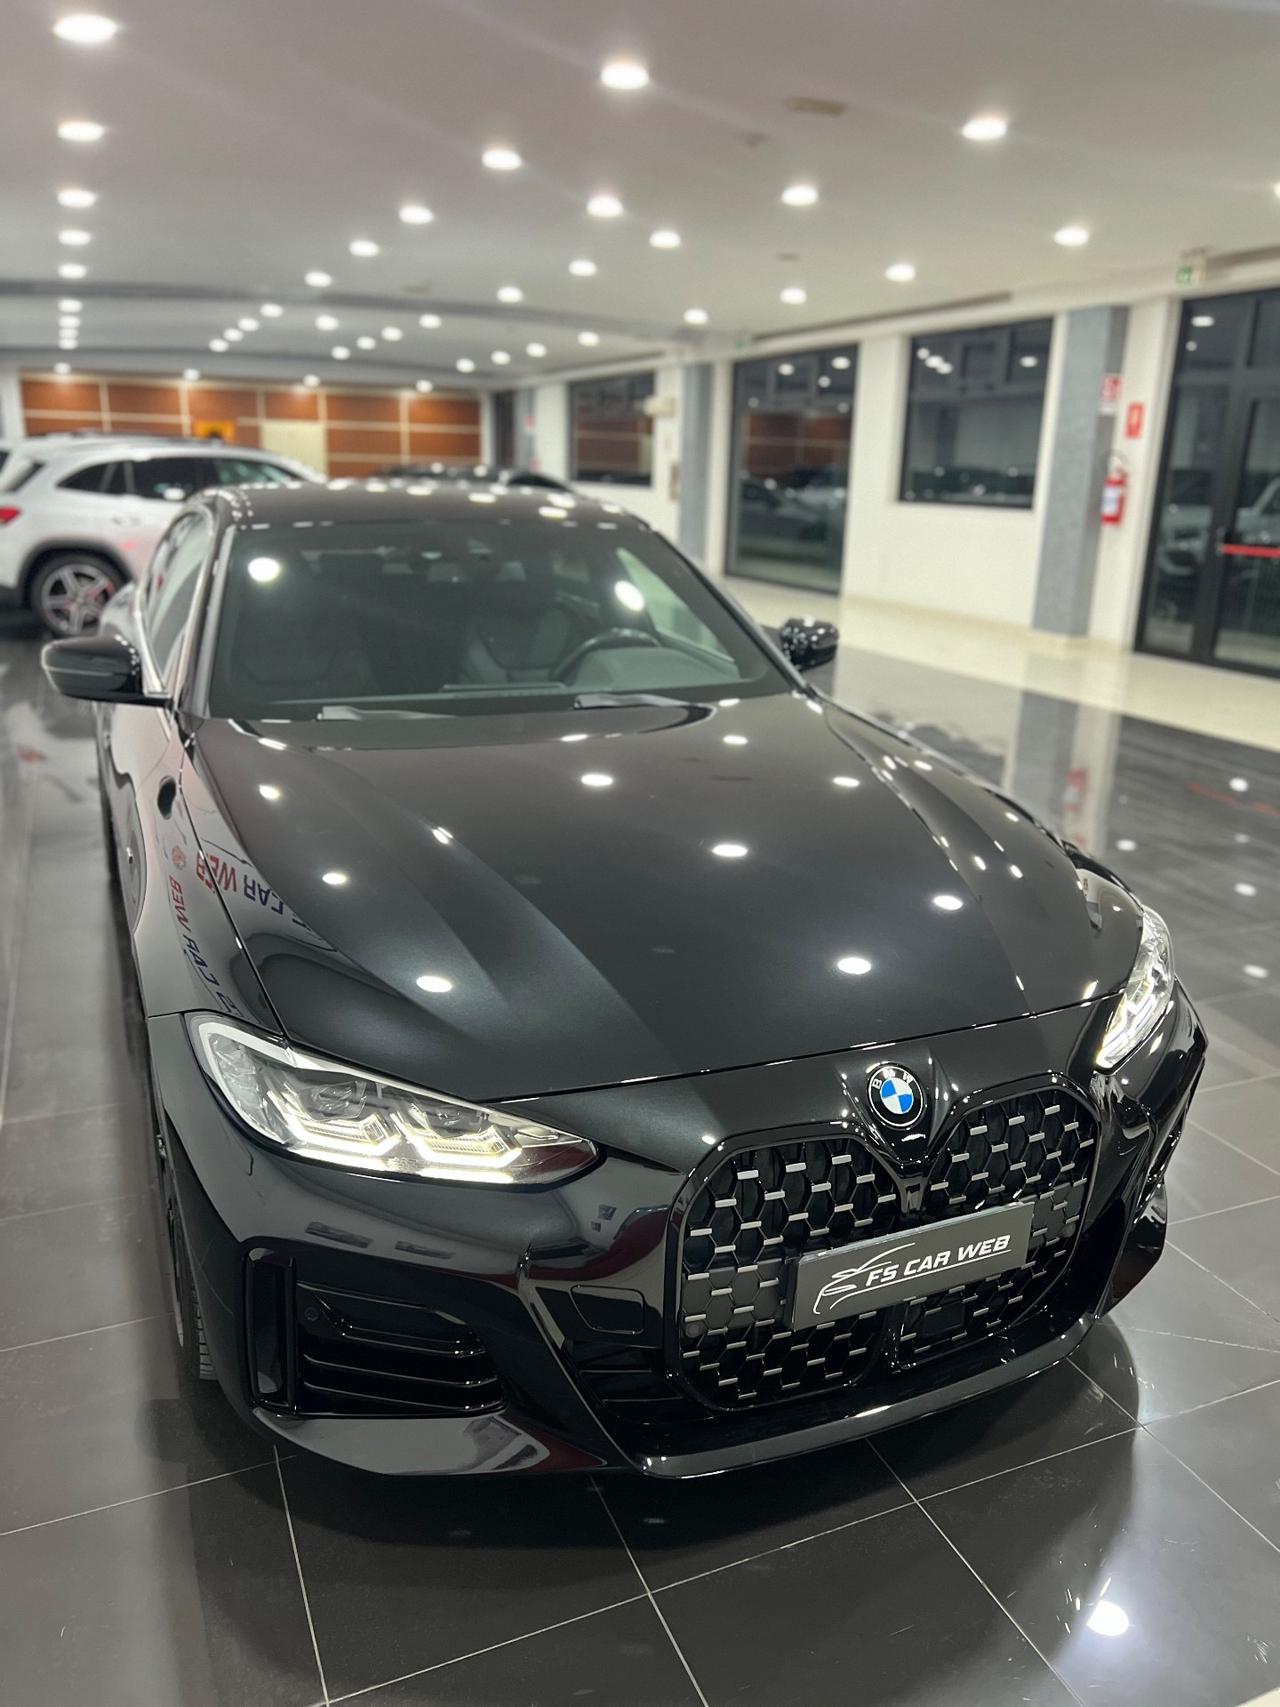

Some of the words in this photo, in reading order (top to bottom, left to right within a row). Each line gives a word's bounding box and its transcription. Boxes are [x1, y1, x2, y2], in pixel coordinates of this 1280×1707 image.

[872, 1069, 914, 1090] BMW
[865, 1263, 900, 1288] FS
[903, 1250, 951, 1276] CAR
[957, 1234, 1011, 1262] WEB
